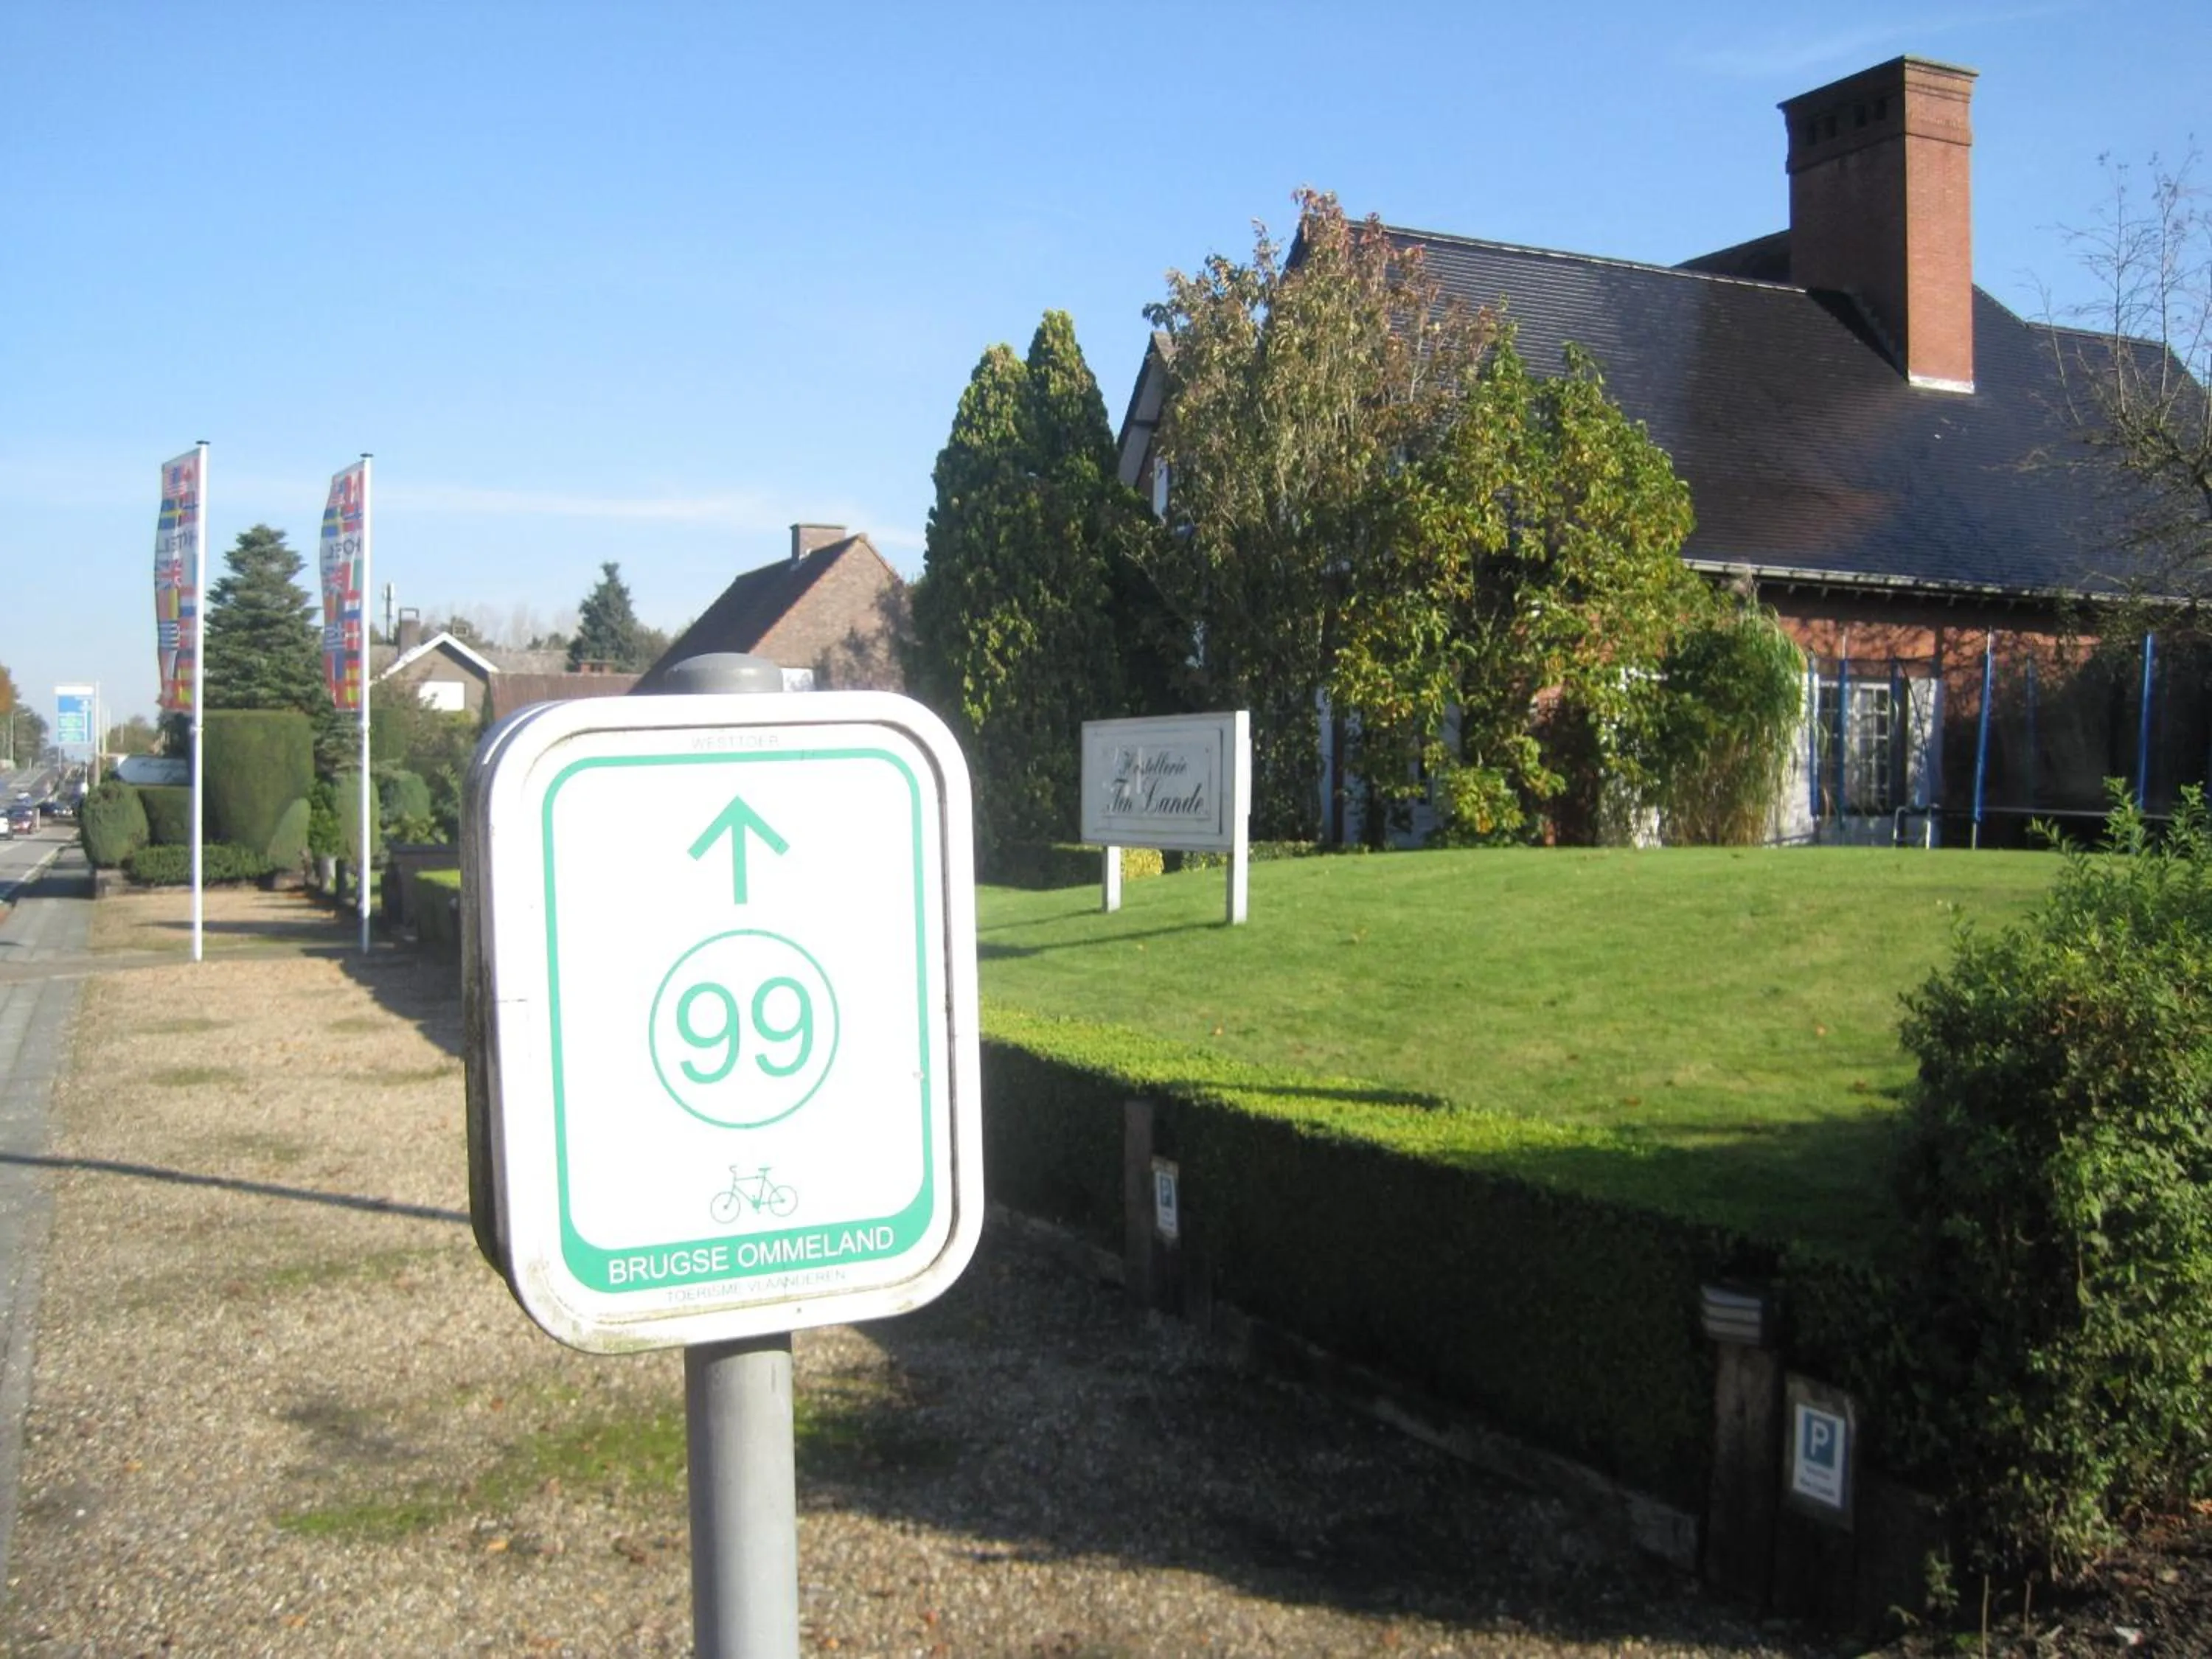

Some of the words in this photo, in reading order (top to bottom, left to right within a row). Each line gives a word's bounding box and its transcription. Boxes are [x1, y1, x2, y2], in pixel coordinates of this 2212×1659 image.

[676, 976, 813, 1084] 99
[608, 1246, 728, 1284] BRUGSE
[737, 1225, 894, 1268] OMMELAND
[666, 1284, 740, 1303] TOERISME
[747, 1270, 846, 1293] VLAANDEREN
[1810, 1419, 1829, 1458] P
